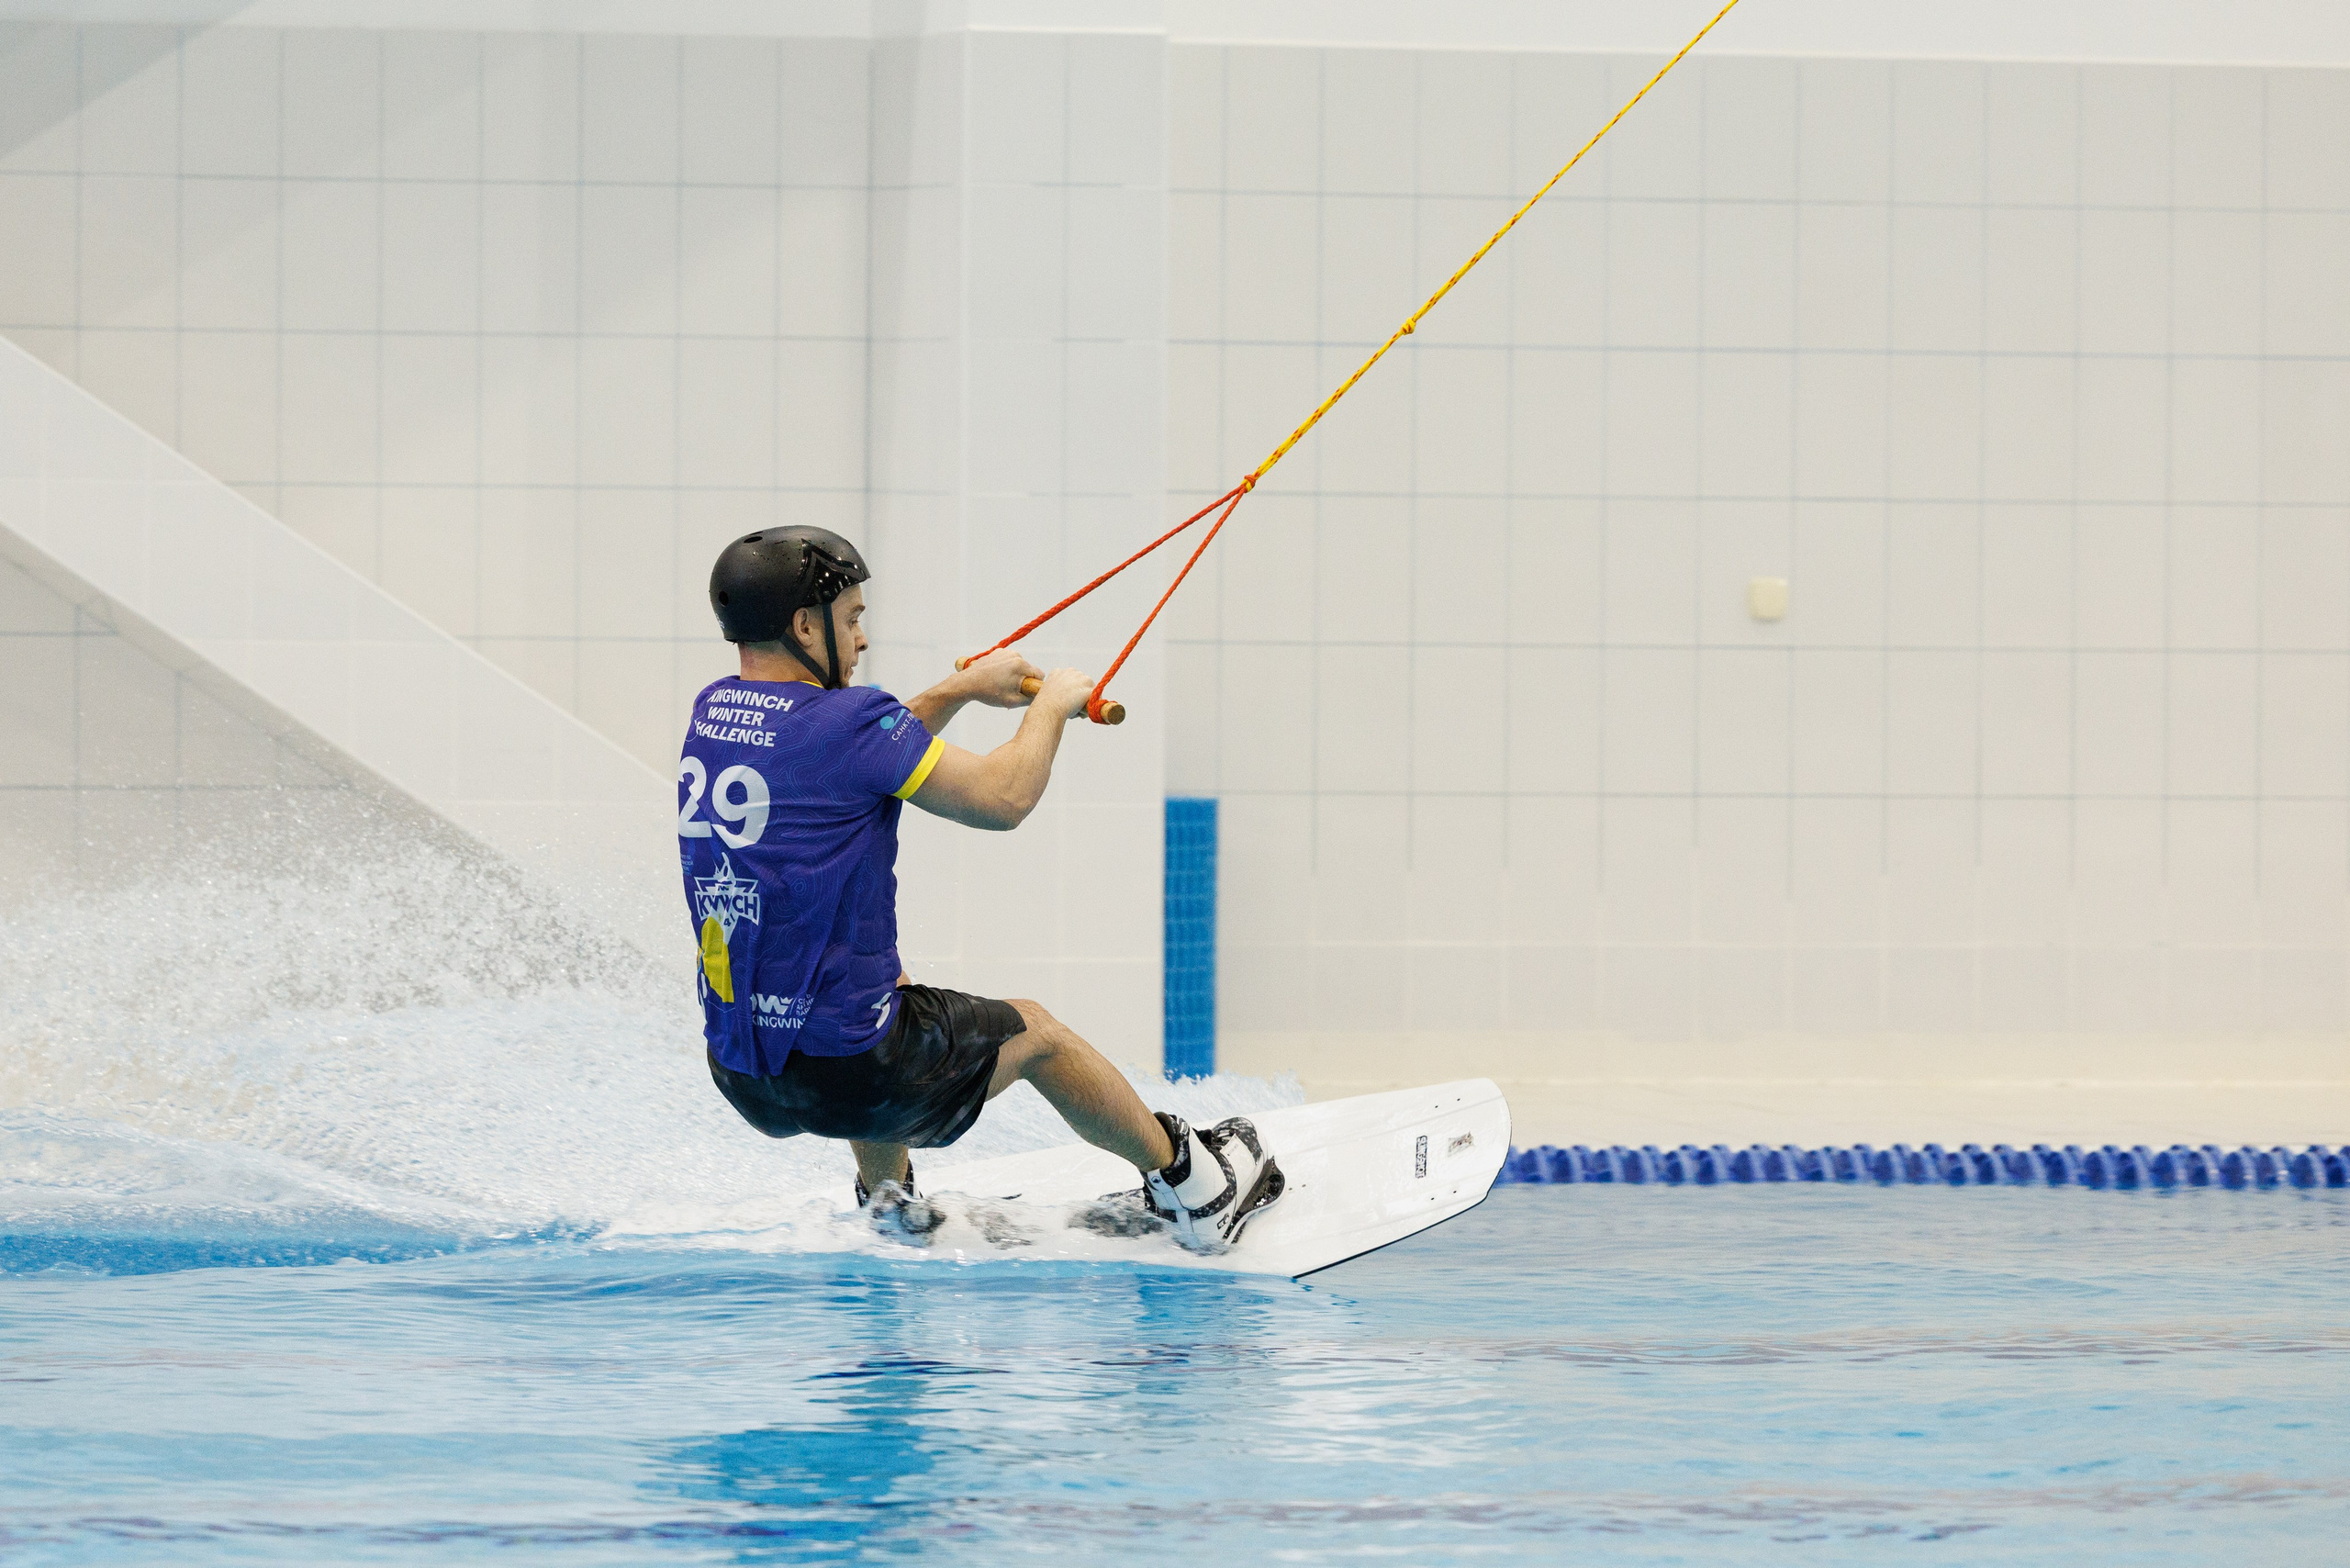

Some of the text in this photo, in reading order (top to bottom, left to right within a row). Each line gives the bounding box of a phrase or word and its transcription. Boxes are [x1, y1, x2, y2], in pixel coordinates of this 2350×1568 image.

[707, 706, 766, 727] WINTER
[694, 720, 777, 747] HALLENGE
[677, 756, 771, 850] 29
